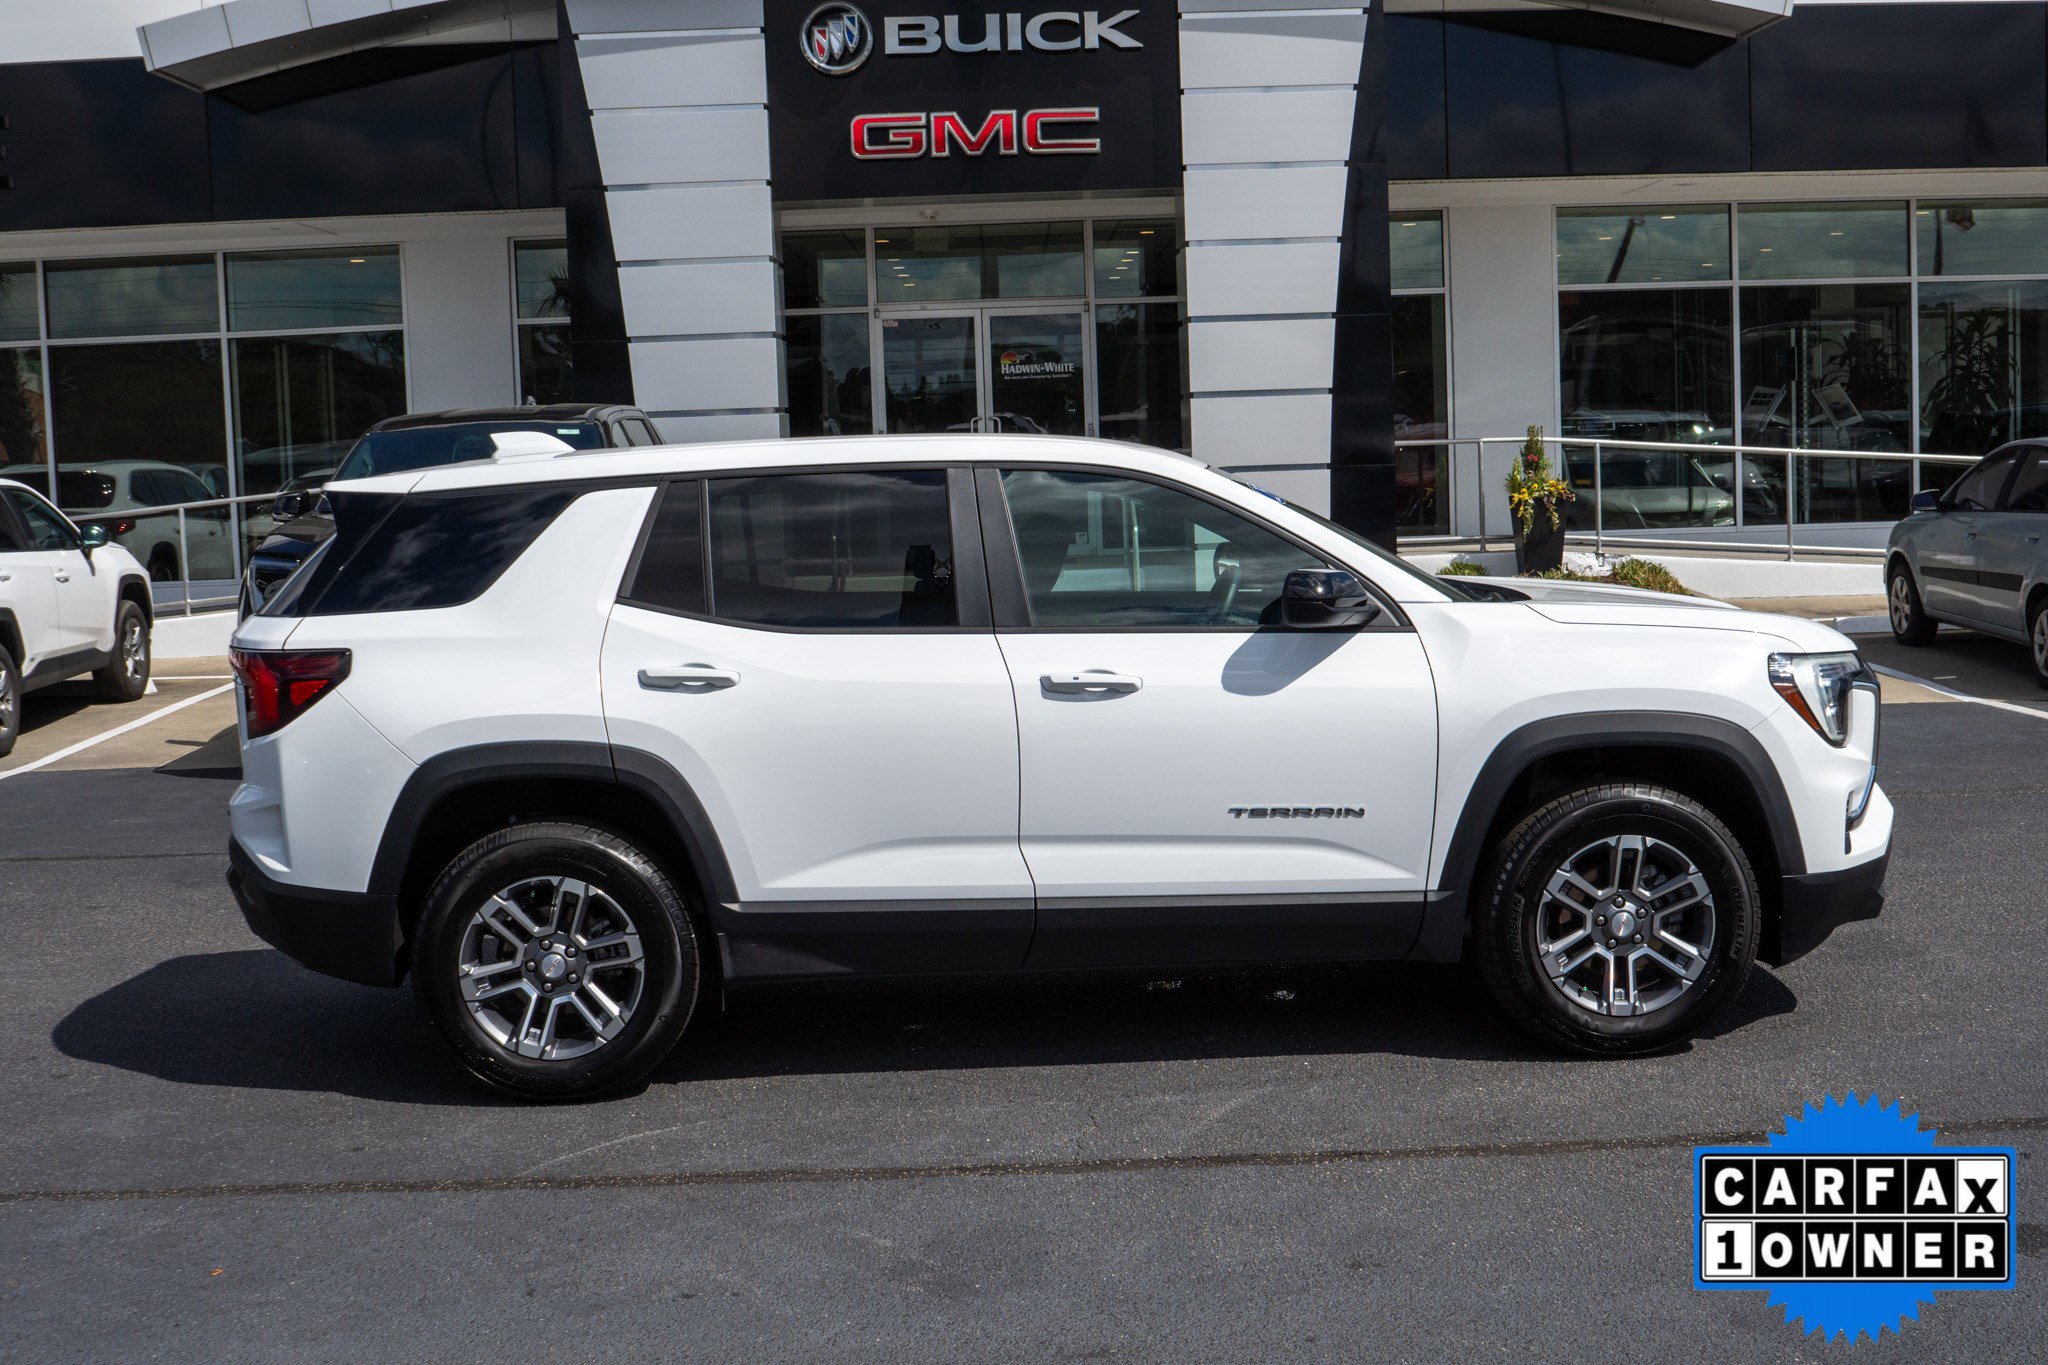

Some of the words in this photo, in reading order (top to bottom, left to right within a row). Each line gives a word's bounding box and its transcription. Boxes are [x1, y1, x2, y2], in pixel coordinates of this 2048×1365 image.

[884, 9, 1144, 55] BUICK
[851, 107, 1100, 159] GMC
[1227, 806, 1365, 818] TERRAIN
